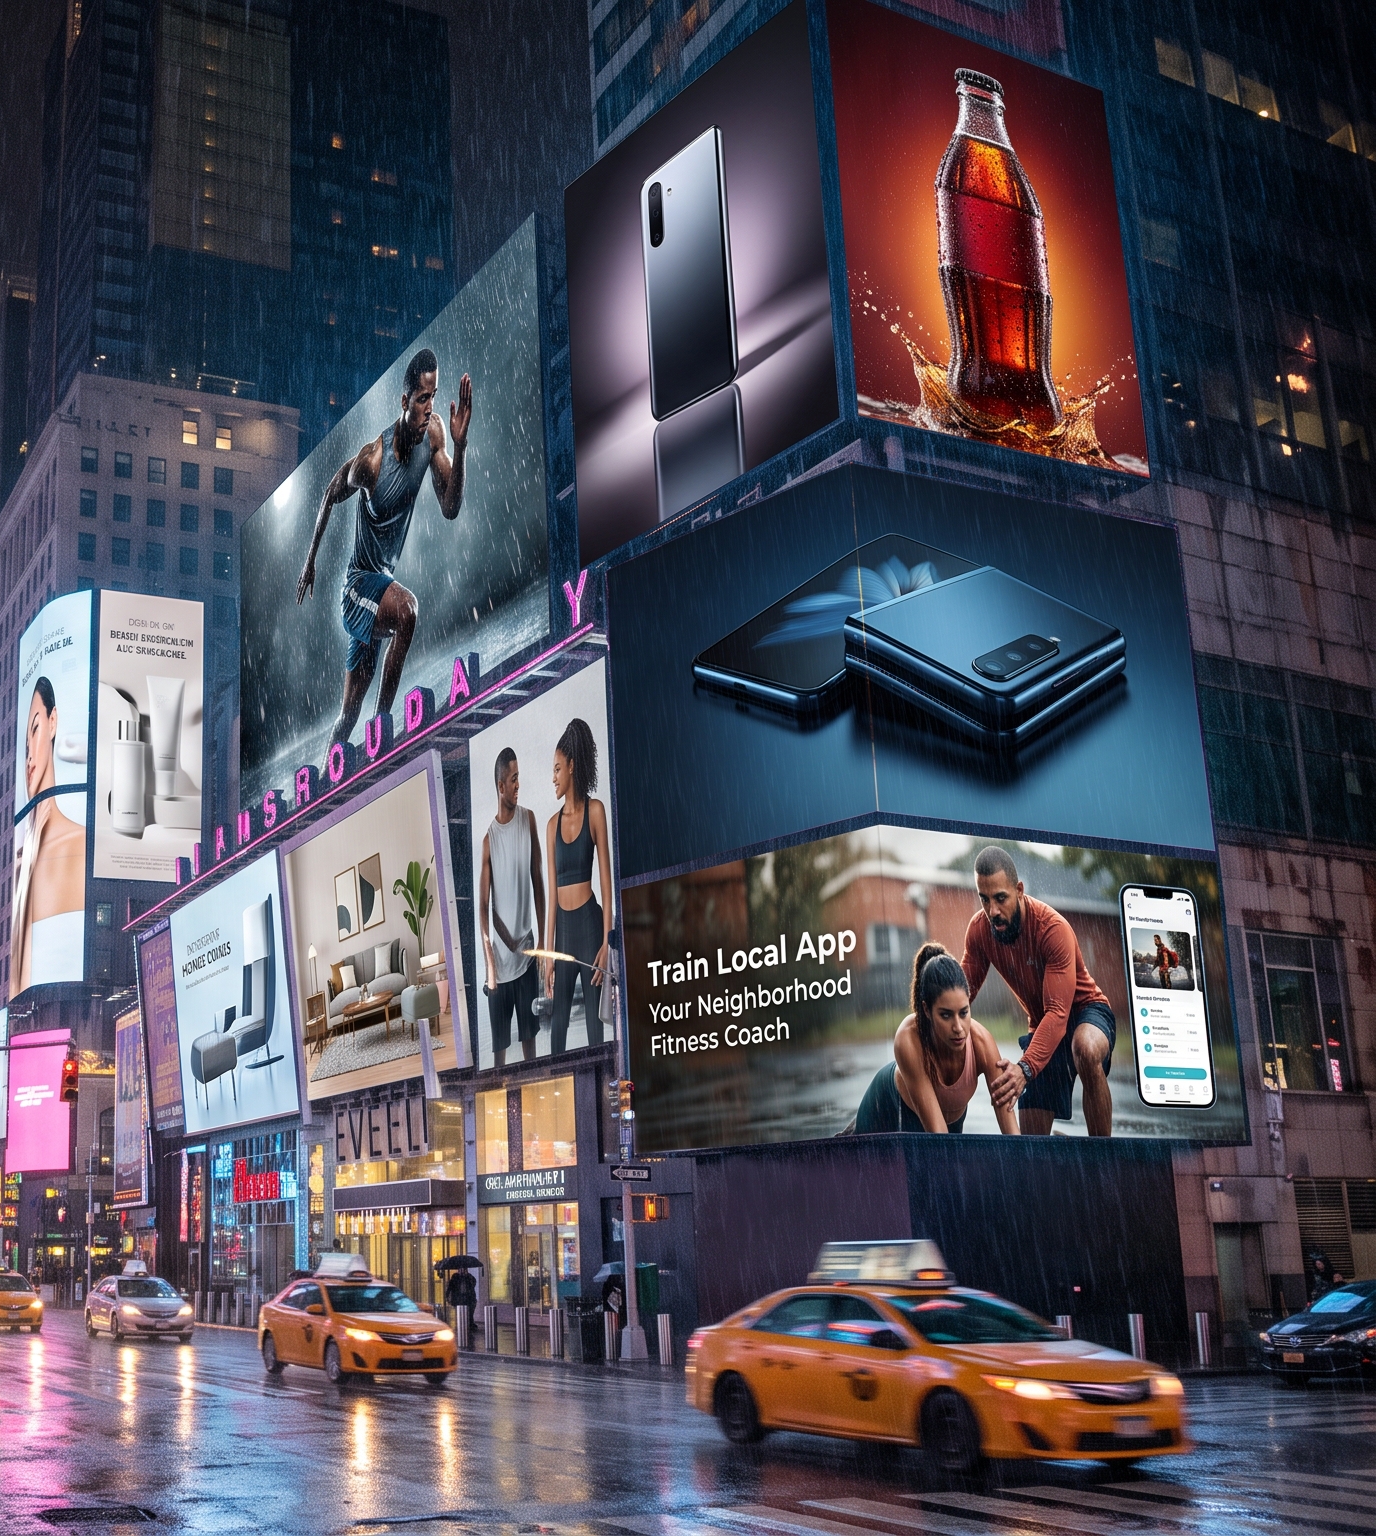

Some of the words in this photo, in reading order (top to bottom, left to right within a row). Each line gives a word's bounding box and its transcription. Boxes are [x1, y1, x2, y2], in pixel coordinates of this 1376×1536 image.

[647, 951, 709, 987] Train
[717, 933, 787, 975] Local
[795, 928, 857, 965] App
[649, 1001, 692, 1023] Your
[698, 969, 852, 1017] Neighborhood
[651, 1031, 719, 1056] Fitness
[724, 1016, 790, 1047] Coach
